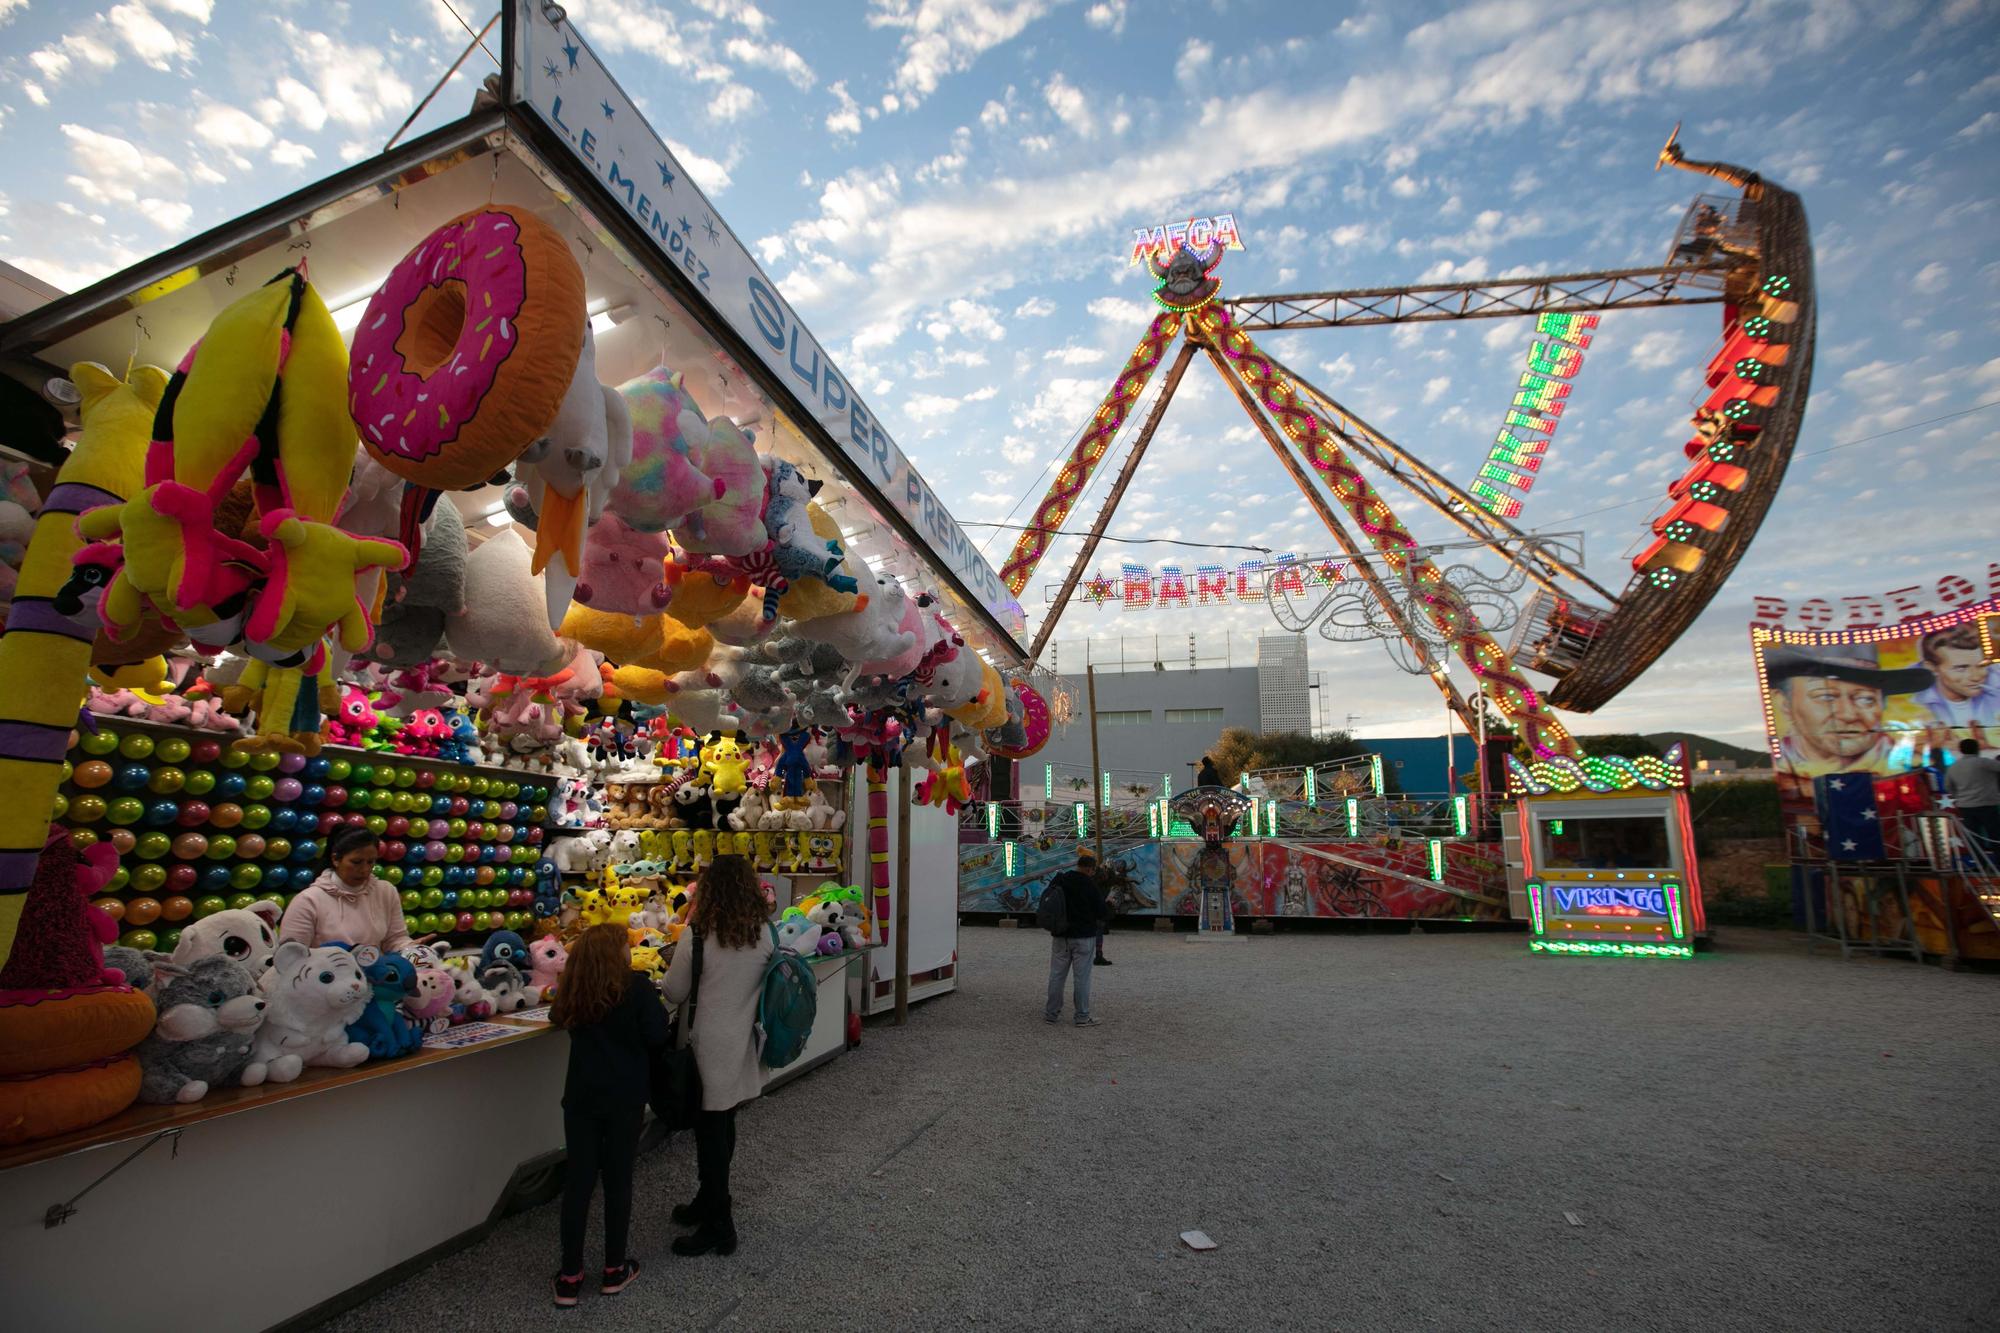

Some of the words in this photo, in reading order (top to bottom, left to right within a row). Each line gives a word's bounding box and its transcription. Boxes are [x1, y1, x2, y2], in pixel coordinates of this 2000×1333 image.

[608, 160, 711, 294] MENDEZ
[1128, 213, 1246, 268] MEGA
[748, 275, 892, 484] SUPER
[906, 470, 997, 604] PREMIOS
[1469, 312, 1601, 520] VIKINGA
[1121, 552, 1310, 612] BARCA
[1750, 574, 1976, 632] RODEO
